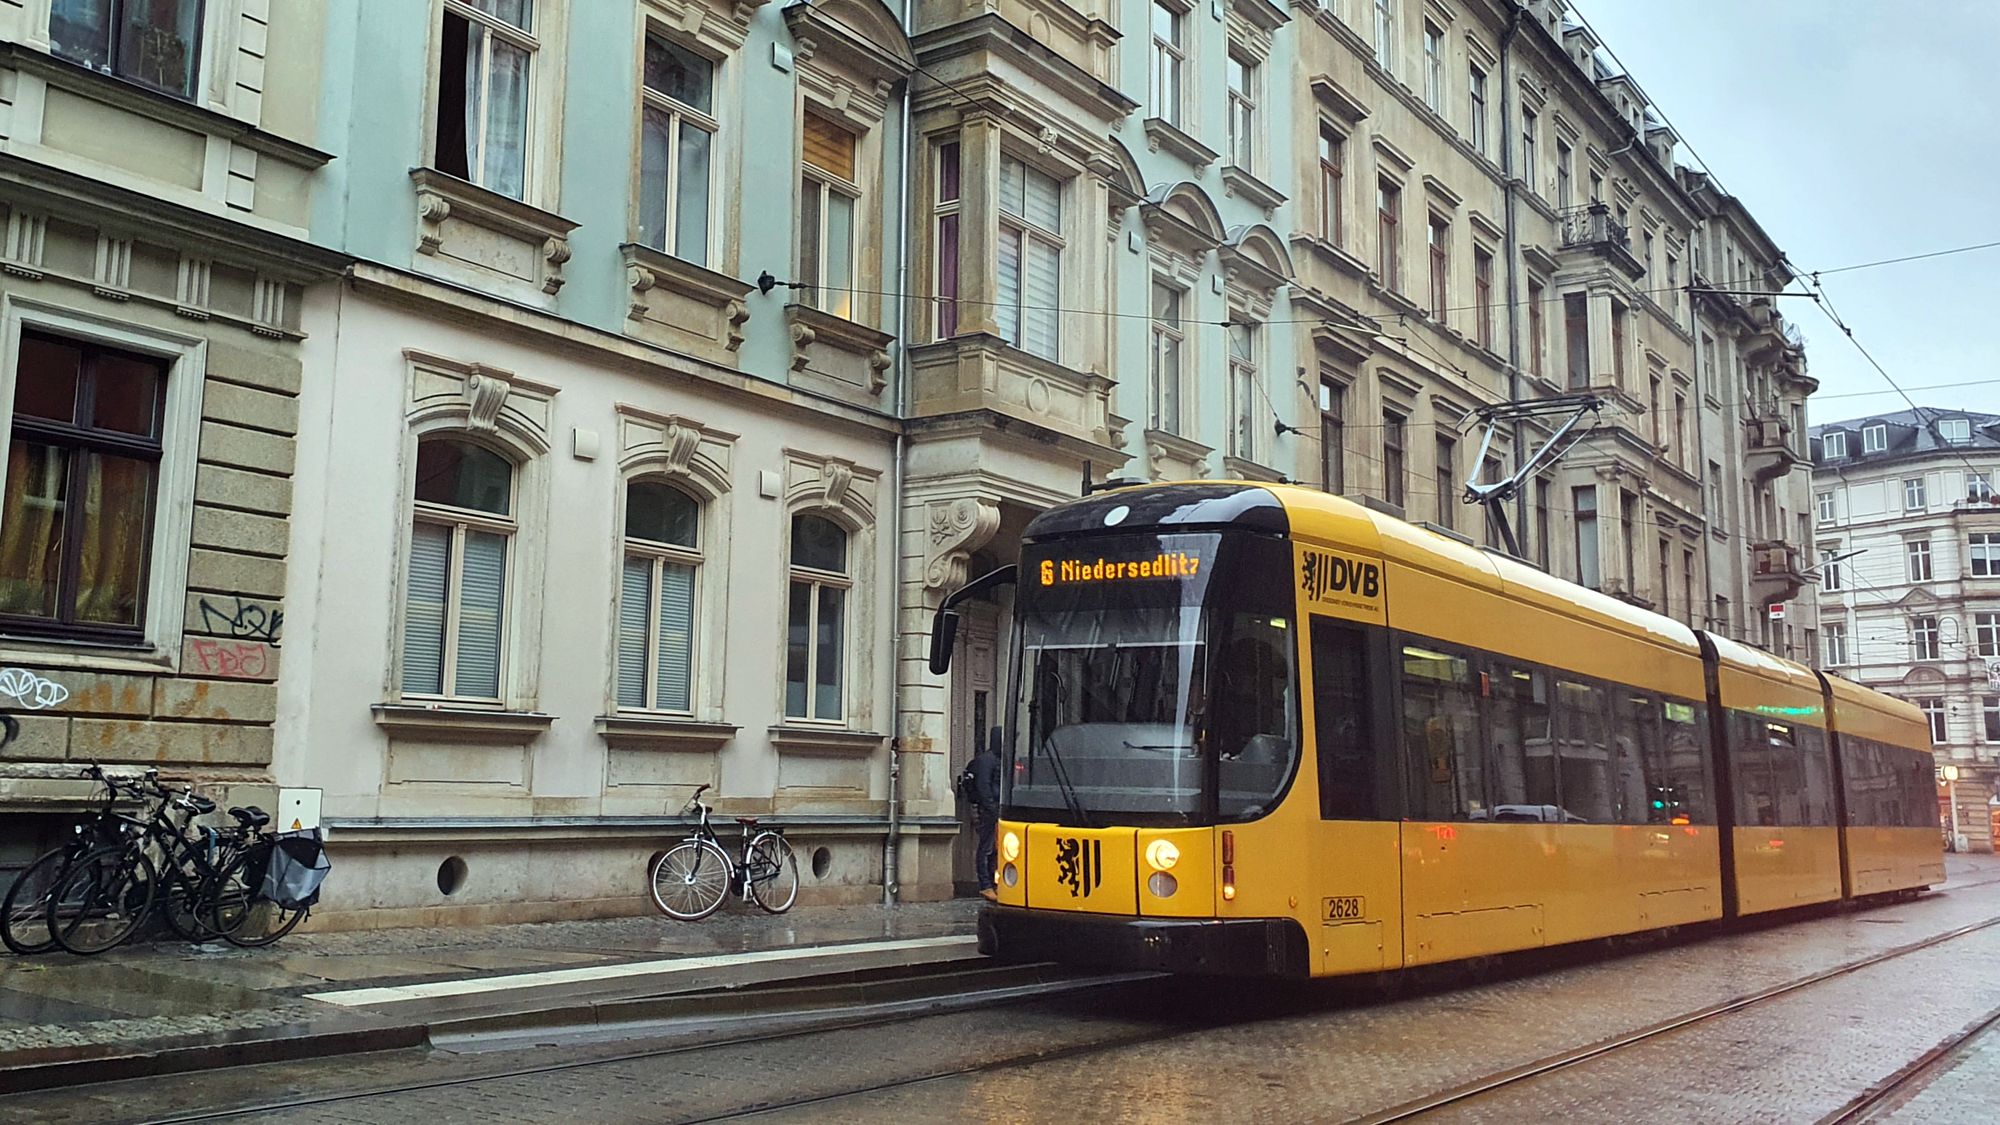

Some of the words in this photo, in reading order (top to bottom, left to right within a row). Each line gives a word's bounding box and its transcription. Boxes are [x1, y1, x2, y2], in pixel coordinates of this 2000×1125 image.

[1040, 559, 1054, 586] 6
[1061, 552, 1200, 582] Niedersedlitz
[1330, 556, 1379, 598] DVB
[1328, 898, 1359, 918] 2628
